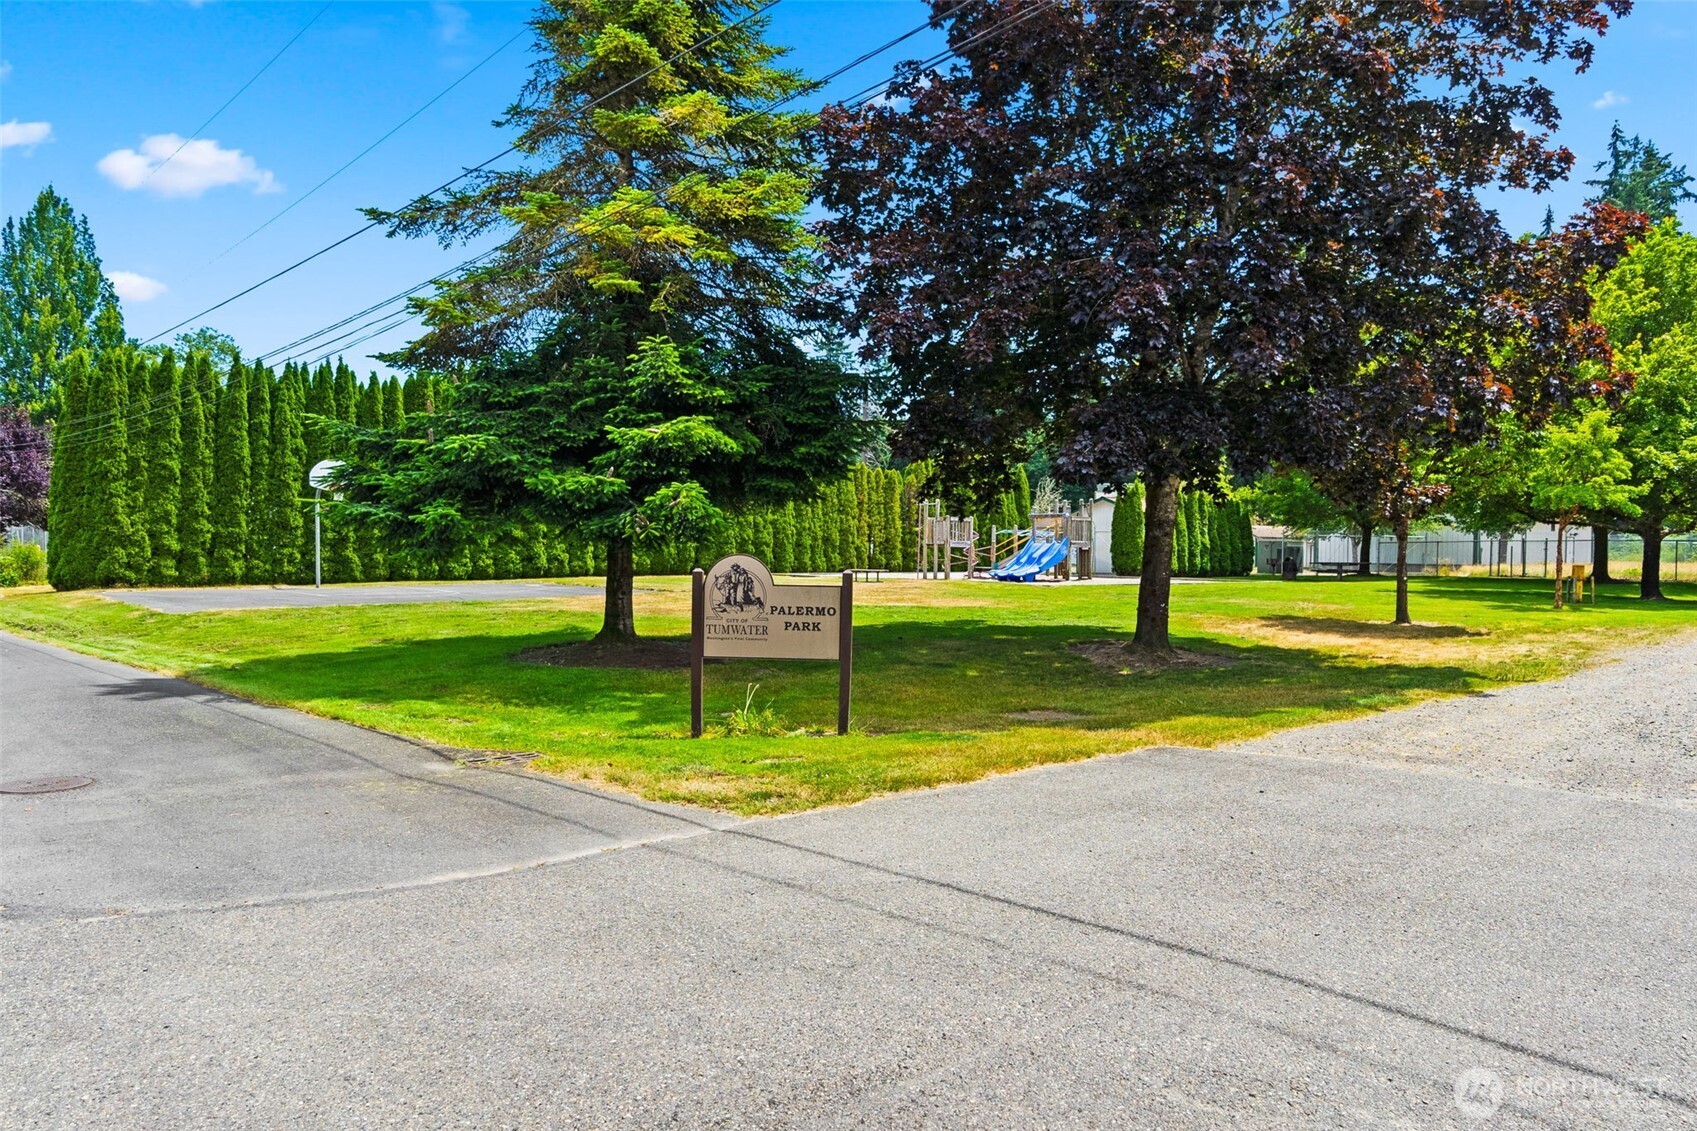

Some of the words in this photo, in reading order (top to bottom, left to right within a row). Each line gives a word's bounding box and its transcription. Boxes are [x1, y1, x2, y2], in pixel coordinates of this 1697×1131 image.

[770, 605, 837, 617] PALERMO
[706, 624, 768, 636] TUMWATER
[784, 621, 822, 631] PARK
